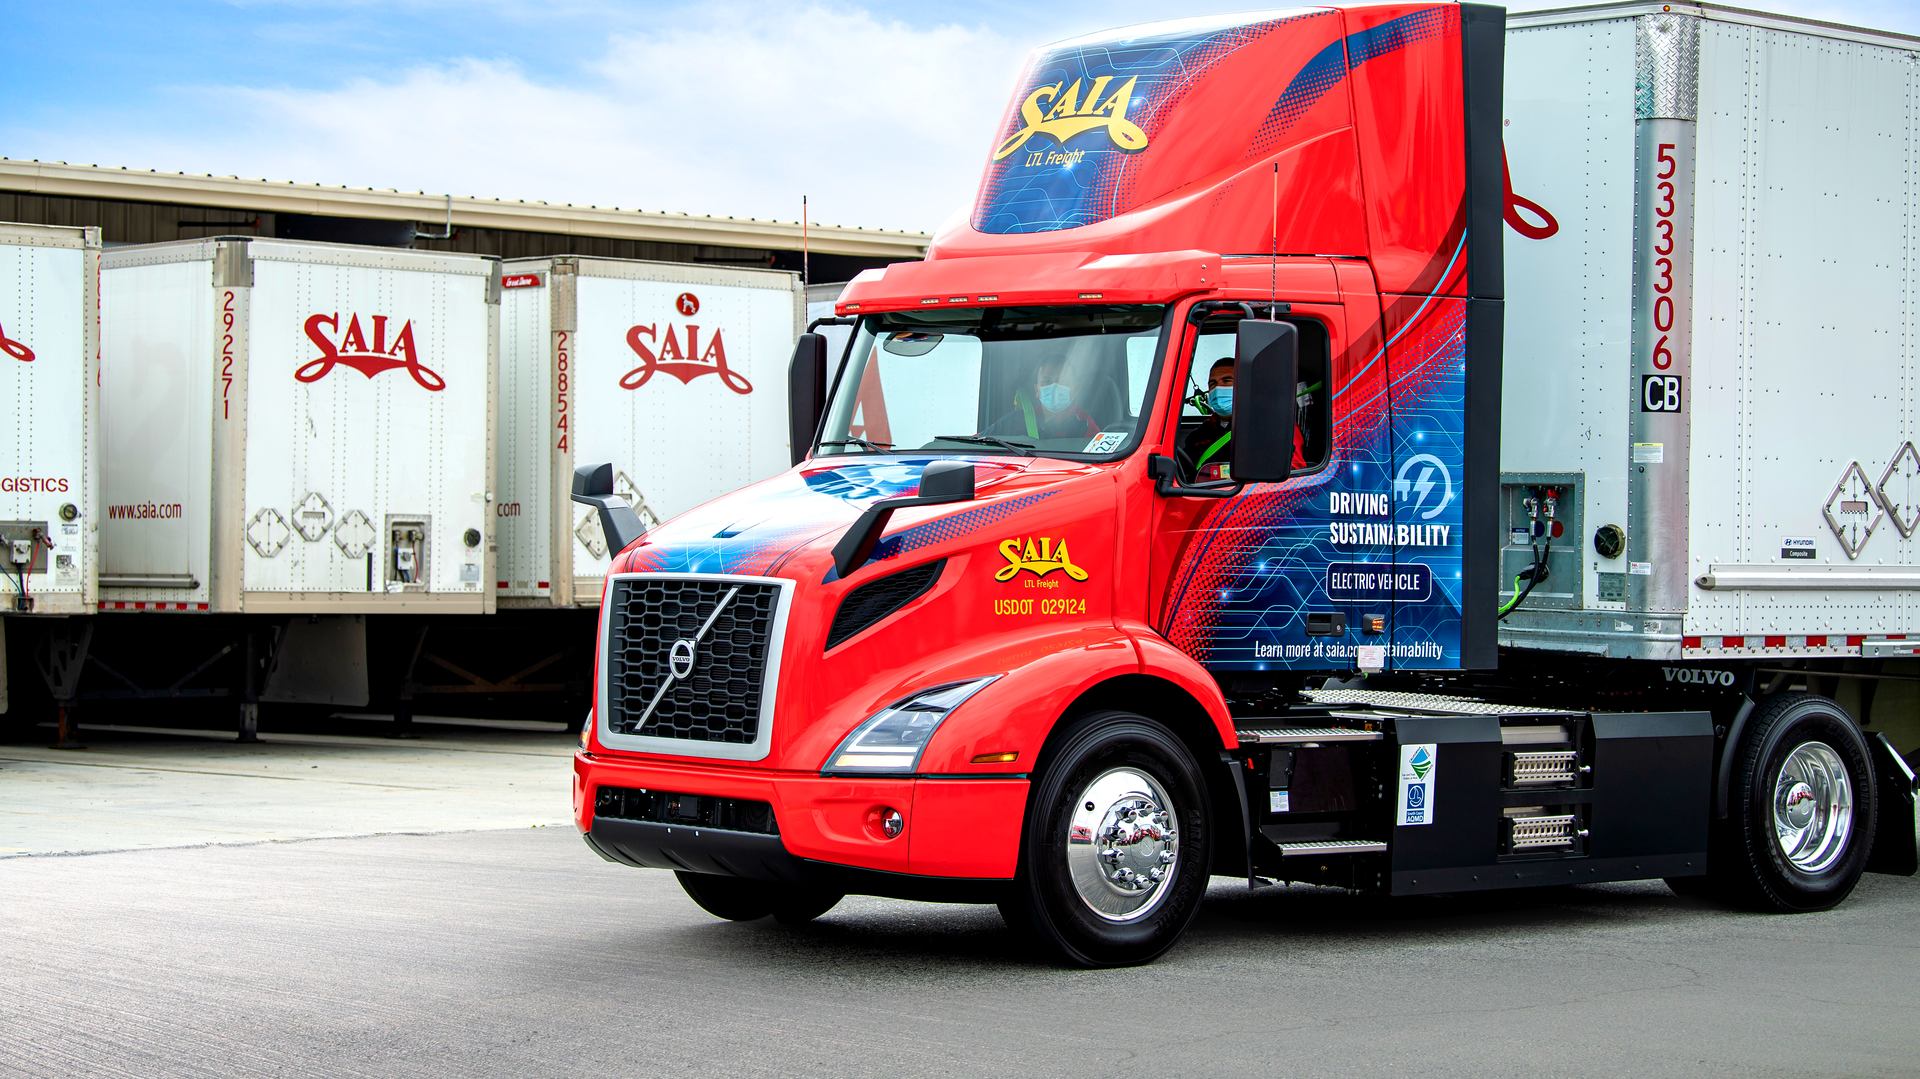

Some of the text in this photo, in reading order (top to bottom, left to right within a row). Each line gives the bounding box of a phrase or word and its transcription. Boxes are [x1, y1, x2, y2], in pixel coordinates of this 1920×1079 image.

[991, 74, 1148, 164] SAIA
[1025, 149, 1085, 167] LTL Freight
[1652, 143, 1677, 371] 533306
[222, 291, 235, 420] 292271
[294, 311, 446, 392] SAIA
[619, 322, 753, 395] SAIA
[557, 332, 568, 453] 288544
[1644, 376, 1679, 411] CB
[108, 500, 182, 520] www.saia.com
[1330, 492, 1388, 516] DRIVING
[1330, 522, 1450, 546] SUSTAINABILITY
[994, 536, 1089, 583] SAIA
[1789, 550, 1808, 558] Composite
[1023, 579, 1059, 589] LTL Freight
[1332, 572, 1420, 591] ELECTRIC VEHICLE
[994, 599, 1087, 616] USDOT 029124
[1255, 641, 1283, 658] Learn
[1286, 644, 1311, 658] more
[1313, 643, 1324, 658] at
[1662, 667, 1735, 686] VOLVO
